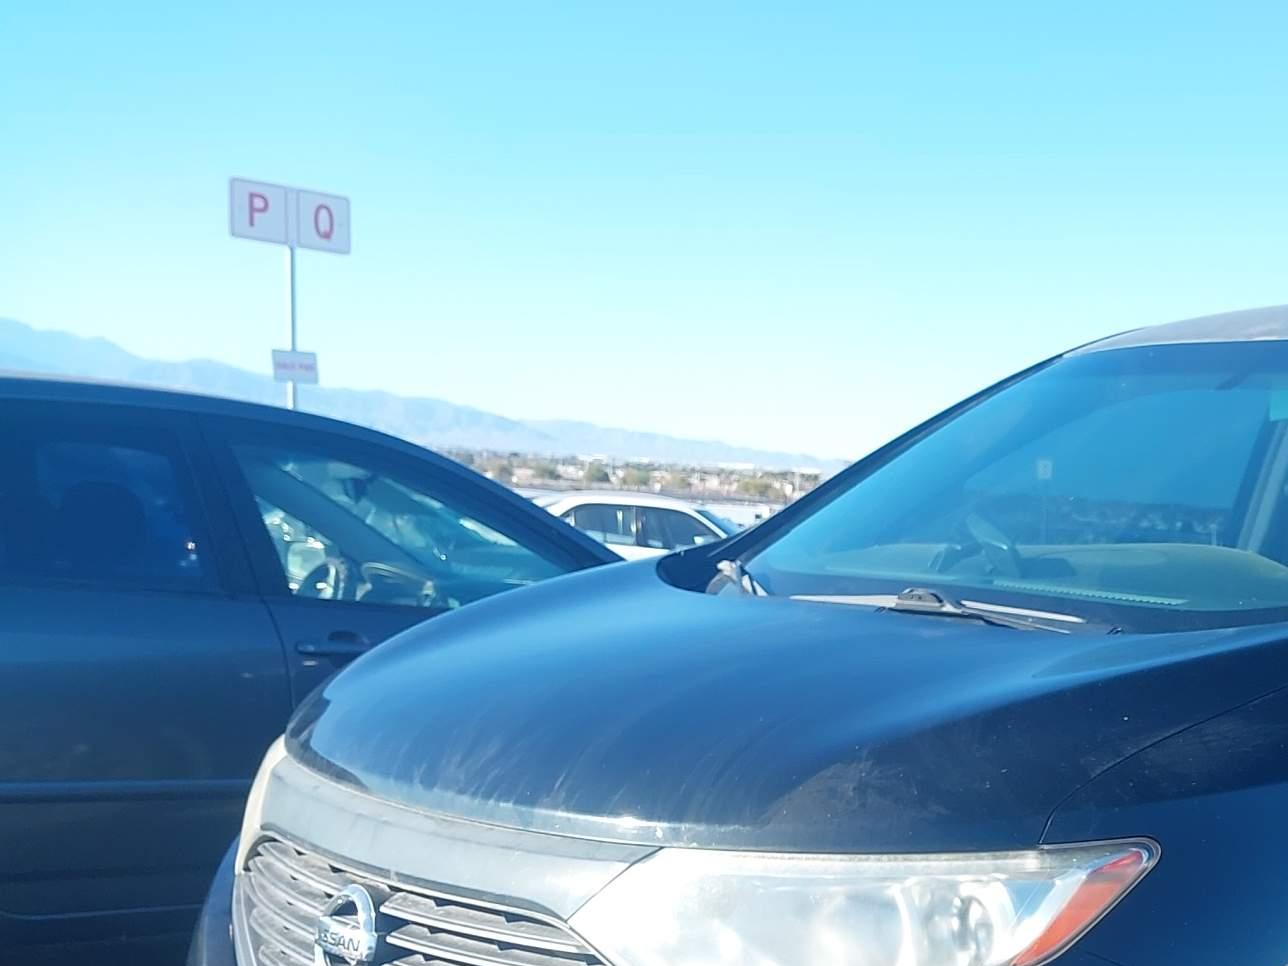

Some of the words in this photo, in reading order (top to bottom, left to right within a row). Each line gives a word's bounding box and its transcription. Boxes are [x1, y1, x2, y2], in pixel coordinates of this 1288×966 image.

[249, 193, 268, 227] P
[314, 204, 333, 239] Q
[317, 927, 361, 952] SSAN
